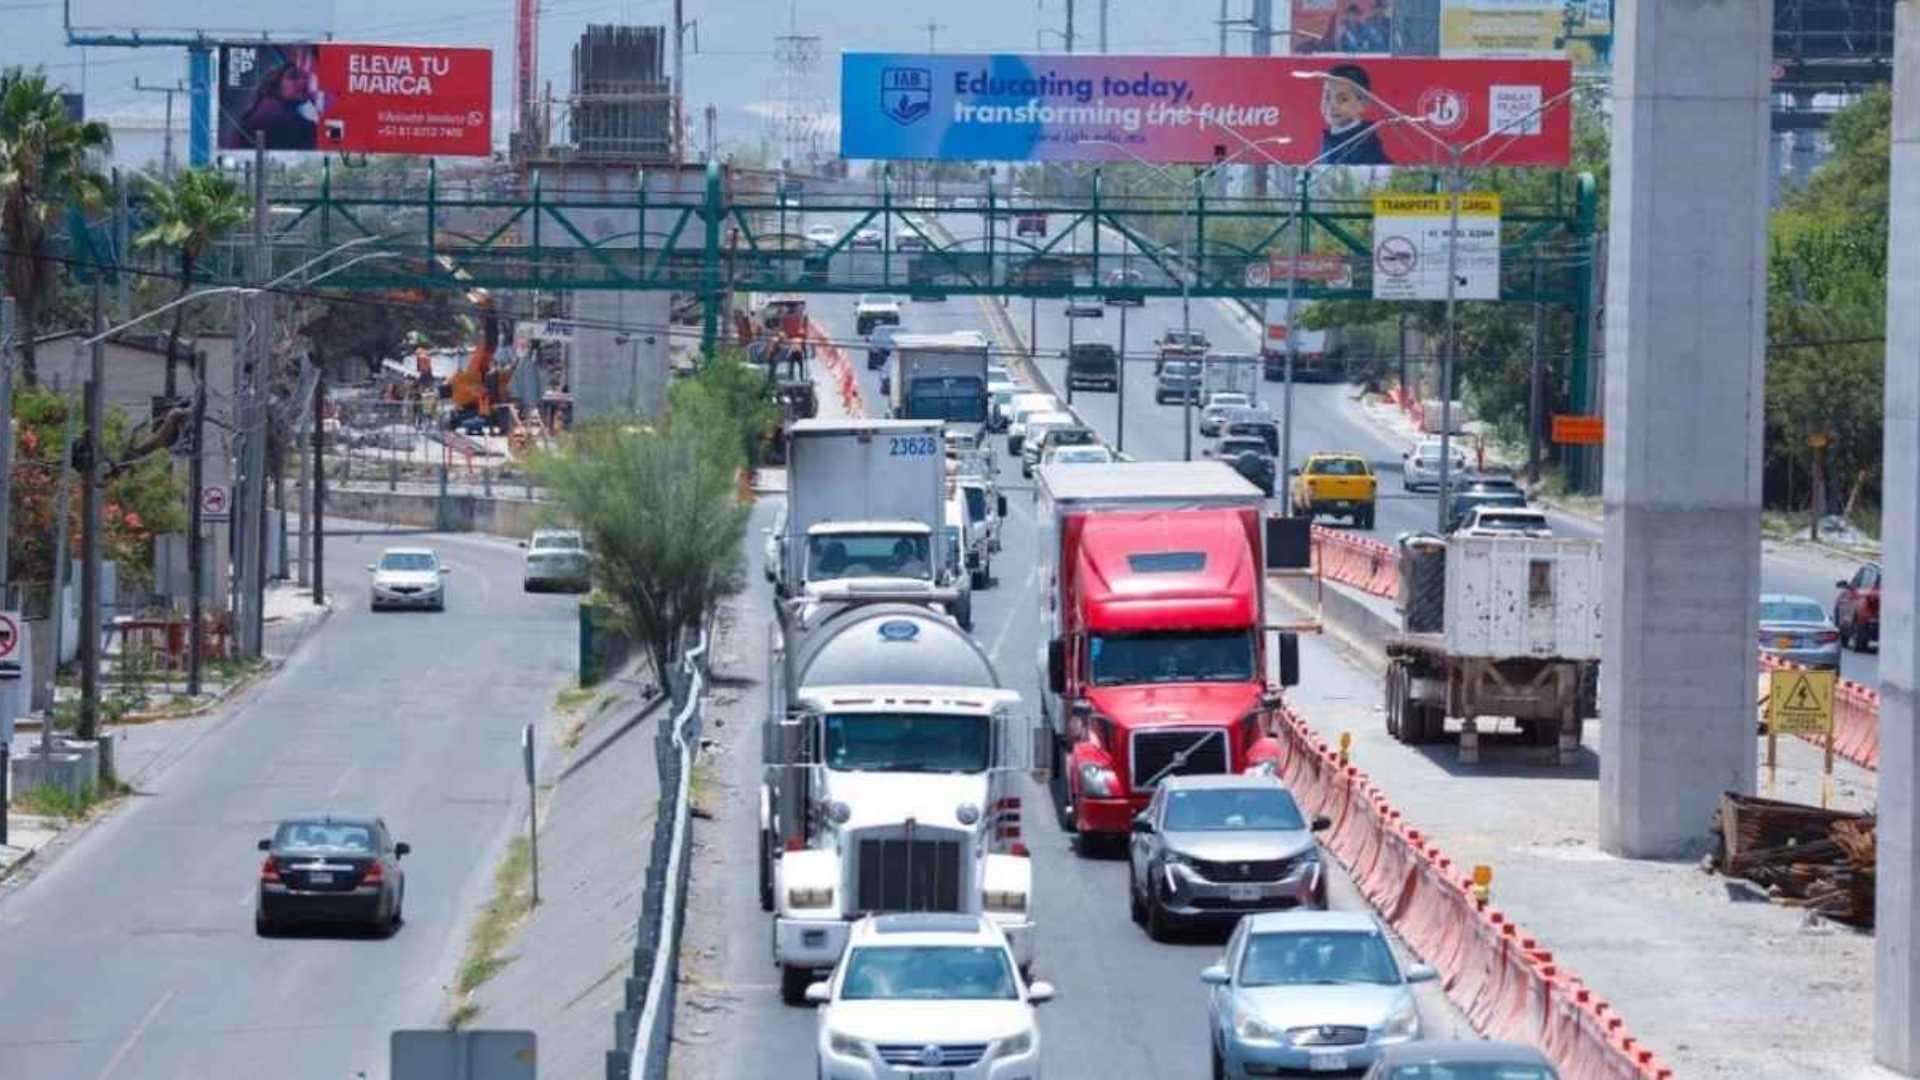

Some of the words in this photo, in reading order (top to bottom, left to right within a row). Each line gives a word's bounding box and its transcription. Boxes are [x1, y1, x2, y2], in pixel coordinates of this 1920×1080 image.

[349, 54, 413, 75] ELEVA
[420, 56, 450, 76] TU
[349, 75, 432, 96] MARCA
[953, 70, 1094, 104] Educating
[1102, 72, 1195, 104] today,
[952, 99, 1142, 132] transforming
[1146, 102, 1192, 127] the
[1198, 102, 1281, 133] future
[1382, 198, 1441, 211] TRANSPORTE
[889, 437, 937, 456] 23628
